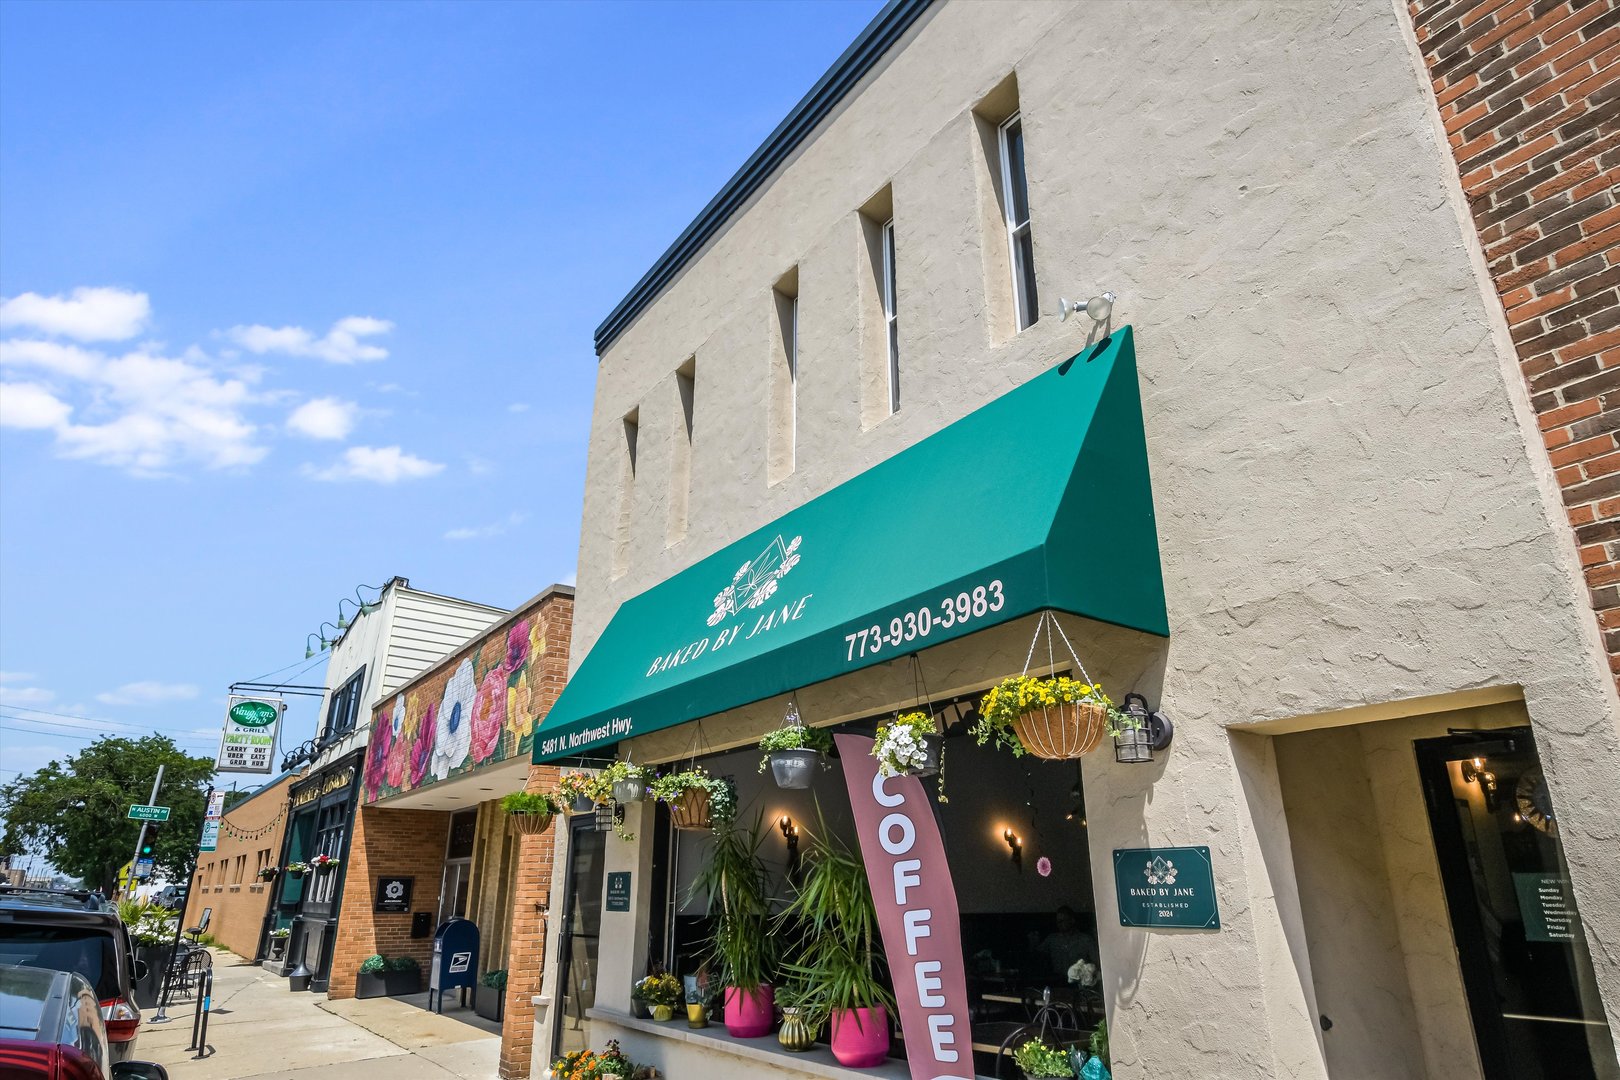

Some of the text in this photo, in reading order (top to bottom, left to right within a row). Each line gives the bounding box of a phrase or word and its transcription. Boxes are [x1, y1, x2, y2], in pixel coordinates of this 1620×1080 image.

[845, 579, 1005, 662] 773-930-3983
[646, 594, 813, 677] BAKED BY JANE
[246, 715, 268, 725] Pub
[225, 733, 273, 746] PARTY ROOM
[541, 717, 633, 756] 5481 N. Northwest Hwy.
[1130, 887, 1195, 897] BAKED BY JANE
[871, 765, 960, 1064] COFFEE
[1158, 910, 1173, 918] 2024
